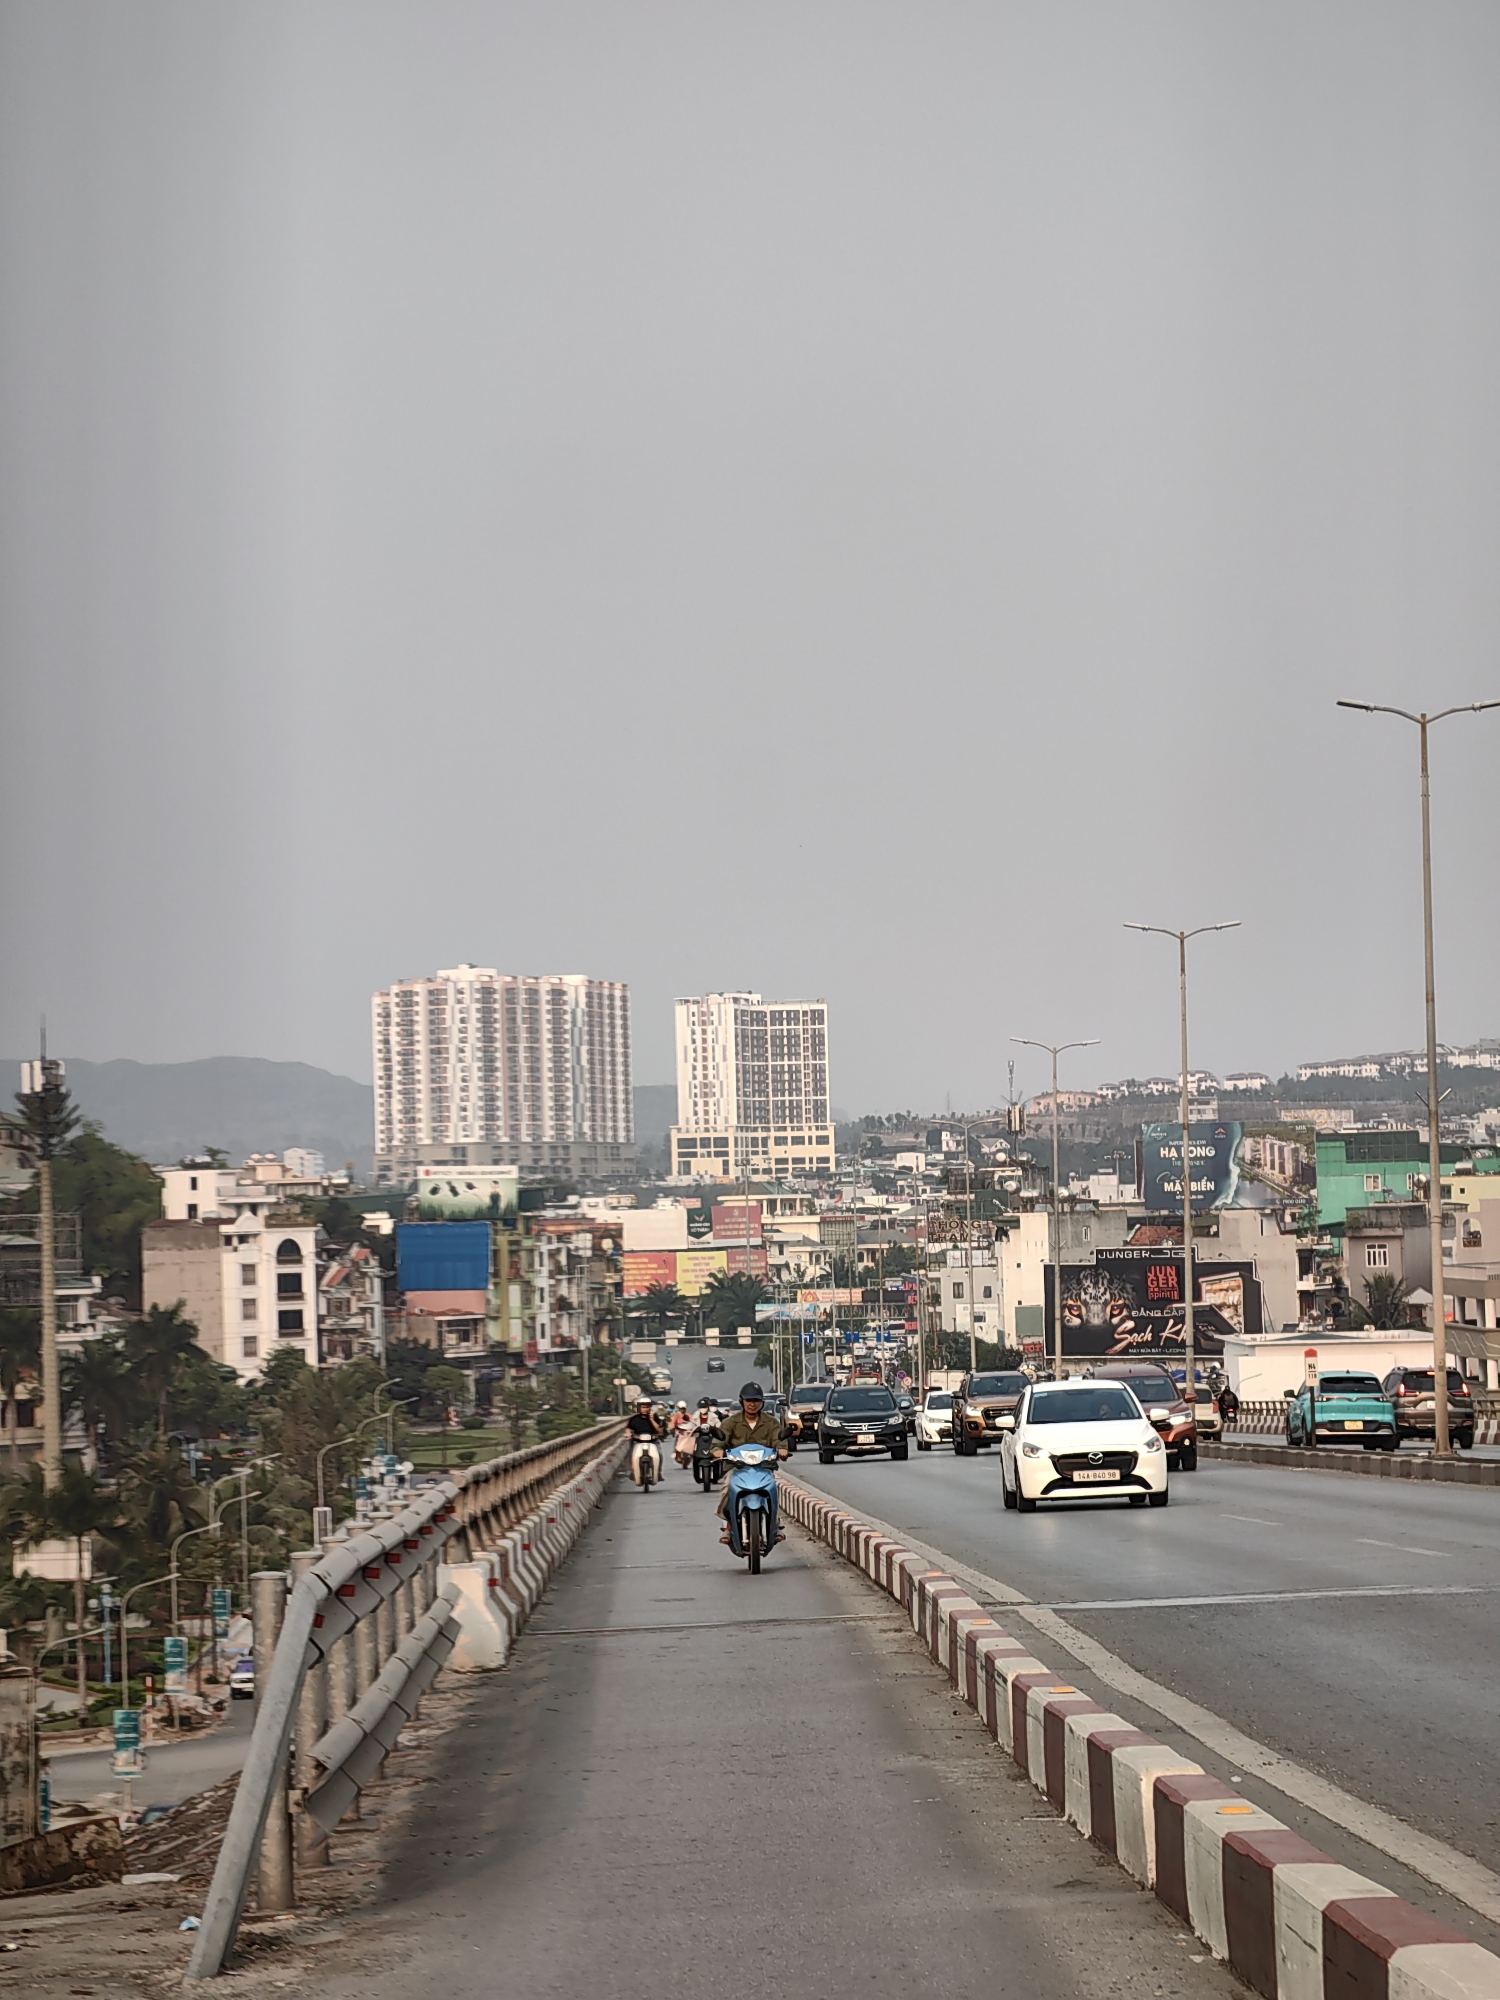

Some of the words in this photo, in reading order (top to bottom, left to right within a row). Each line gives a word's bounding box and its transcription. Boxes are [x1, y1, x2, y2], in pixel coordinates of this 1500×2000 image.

[1160, 1147, 1178, 1160] HẠ
[1164, 1179, 1185, 1194] MẶ
[1098, 1250, 1150, 1259] JUNGER
[1147, 1276, 1178, 1288] GER
[1105, 1319, 1152, 1354] Sạch
[1159, 1318, 1188, 1346] Kh
